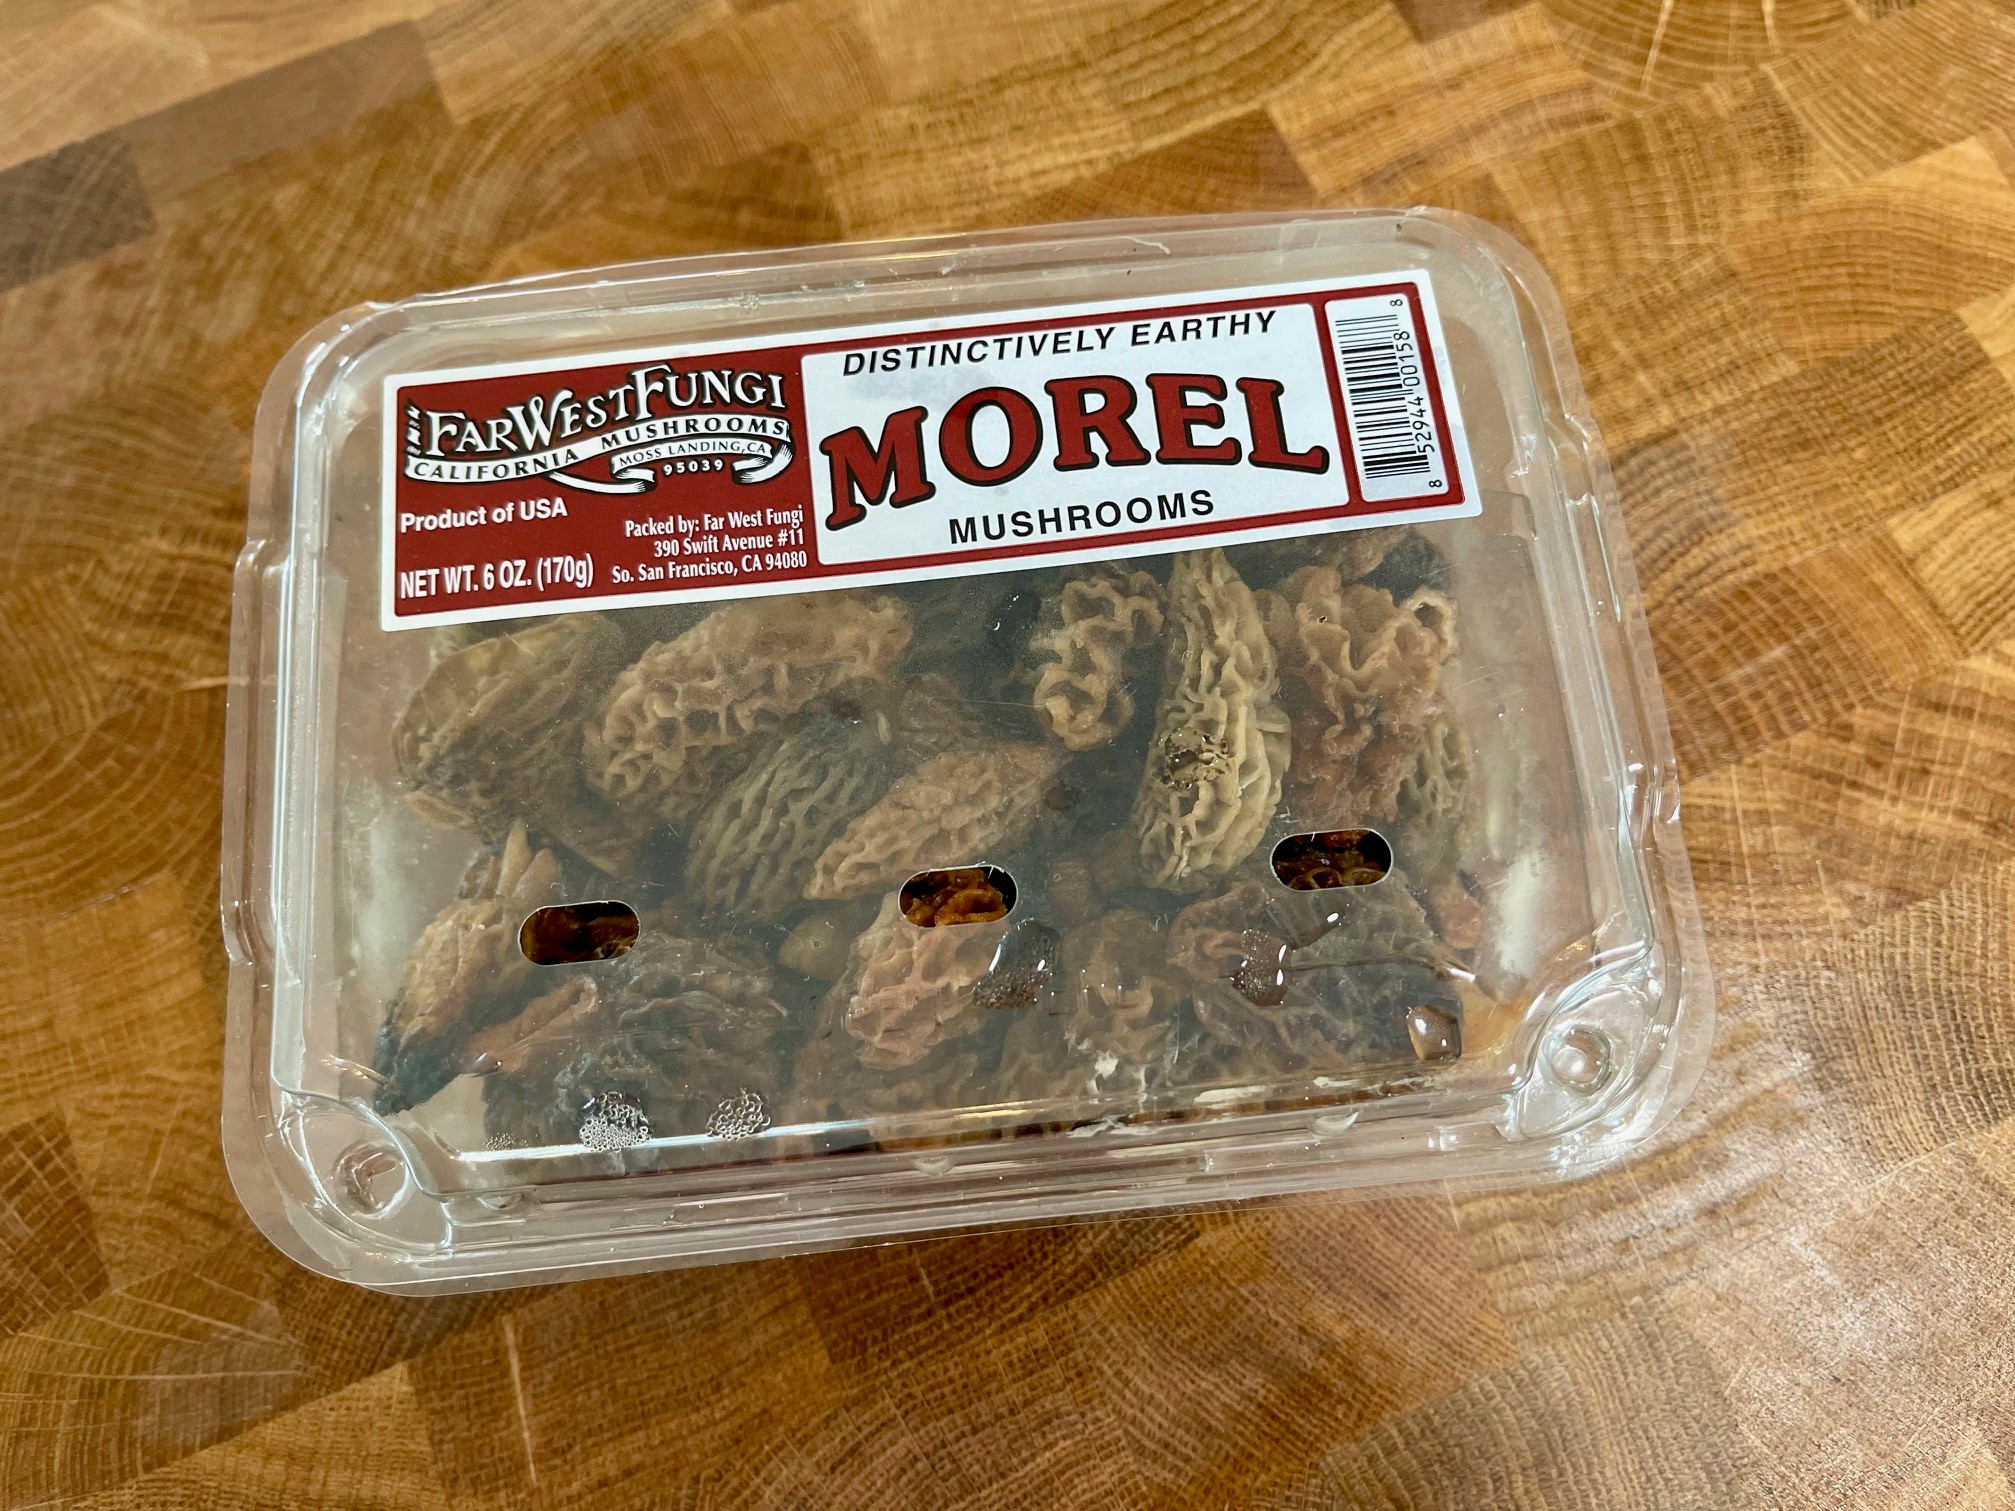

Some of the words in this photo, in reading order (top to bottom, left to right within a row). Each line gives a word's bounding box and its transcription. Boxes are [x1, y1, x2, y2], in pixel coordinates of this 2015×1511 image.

[843, 326, 1116, 377] DISTINCTIVELY
[1131, 309, 1277, 347] EARTHY
[1392, 330, 1421, 387] 00158
[1407, 395, 1435, 453] 52944
[414, 447, 580, 481] CALIFORNIA
[600, 416, 786, 450] MUSHROOMS
[619, 449, 662, 467] MOSS
[663, 459, 724, 477] 95039
[819, 373, 1330, 531] MOREL
[399, 505, 488, 534] Product
[491, 501, 515, 524] of
[519, 496, 568, 521] USA
[624, 514, 675, 538] Packed
[678, 514, 701, 538] by:
[703, 512, 725, 532] Far
[727, 508, 763, 529] West
[765, 503, 805, 529] Fungi
[949, 489, 1215, 545] MUSHROOMS
[612, 564, 635, 585] So.
[637, 562, 665, 582] San
[667, 556, 739, 578] Francisco,
[740, 554, 763, 573] CA
[765, 548, 808, 571] 94080
[653, 538, 680, 559] 390
[682, 534, 720, 556] Swift
[721, 532, 774, 552] Avenue
[777, 527, 805, 548] #11
[399, 567, 441, 600] NET
[443, 563, 480, 595] WT.
[483, 561, 496, 591] 6
[499, 558, 533, 589] OZ.
[535, 552, 595, 592] (170g)
